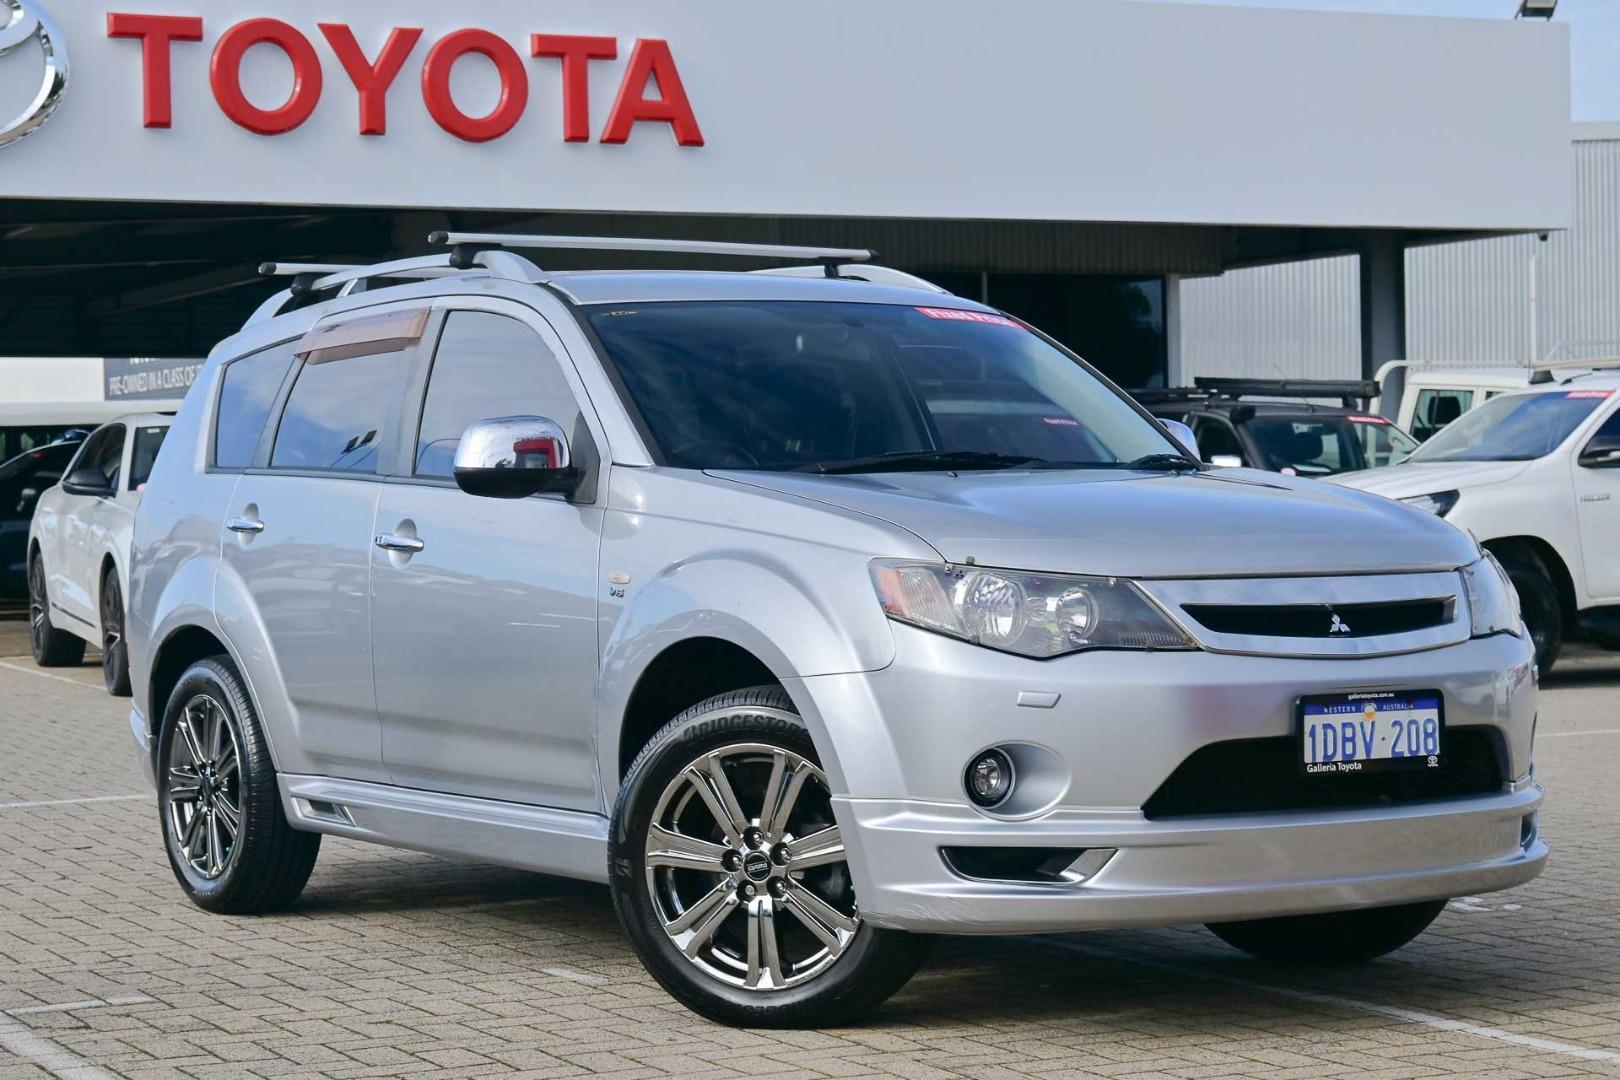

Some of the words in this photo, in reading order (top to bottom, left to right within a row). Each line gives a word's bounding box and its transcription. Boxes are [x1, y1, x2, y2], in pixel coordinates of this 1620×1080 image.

[106, 12, 705, 147] TOYOTA
[1306, 763, 1337, 773] Galleria
[1337, 761, 1362, 771] Toyota
